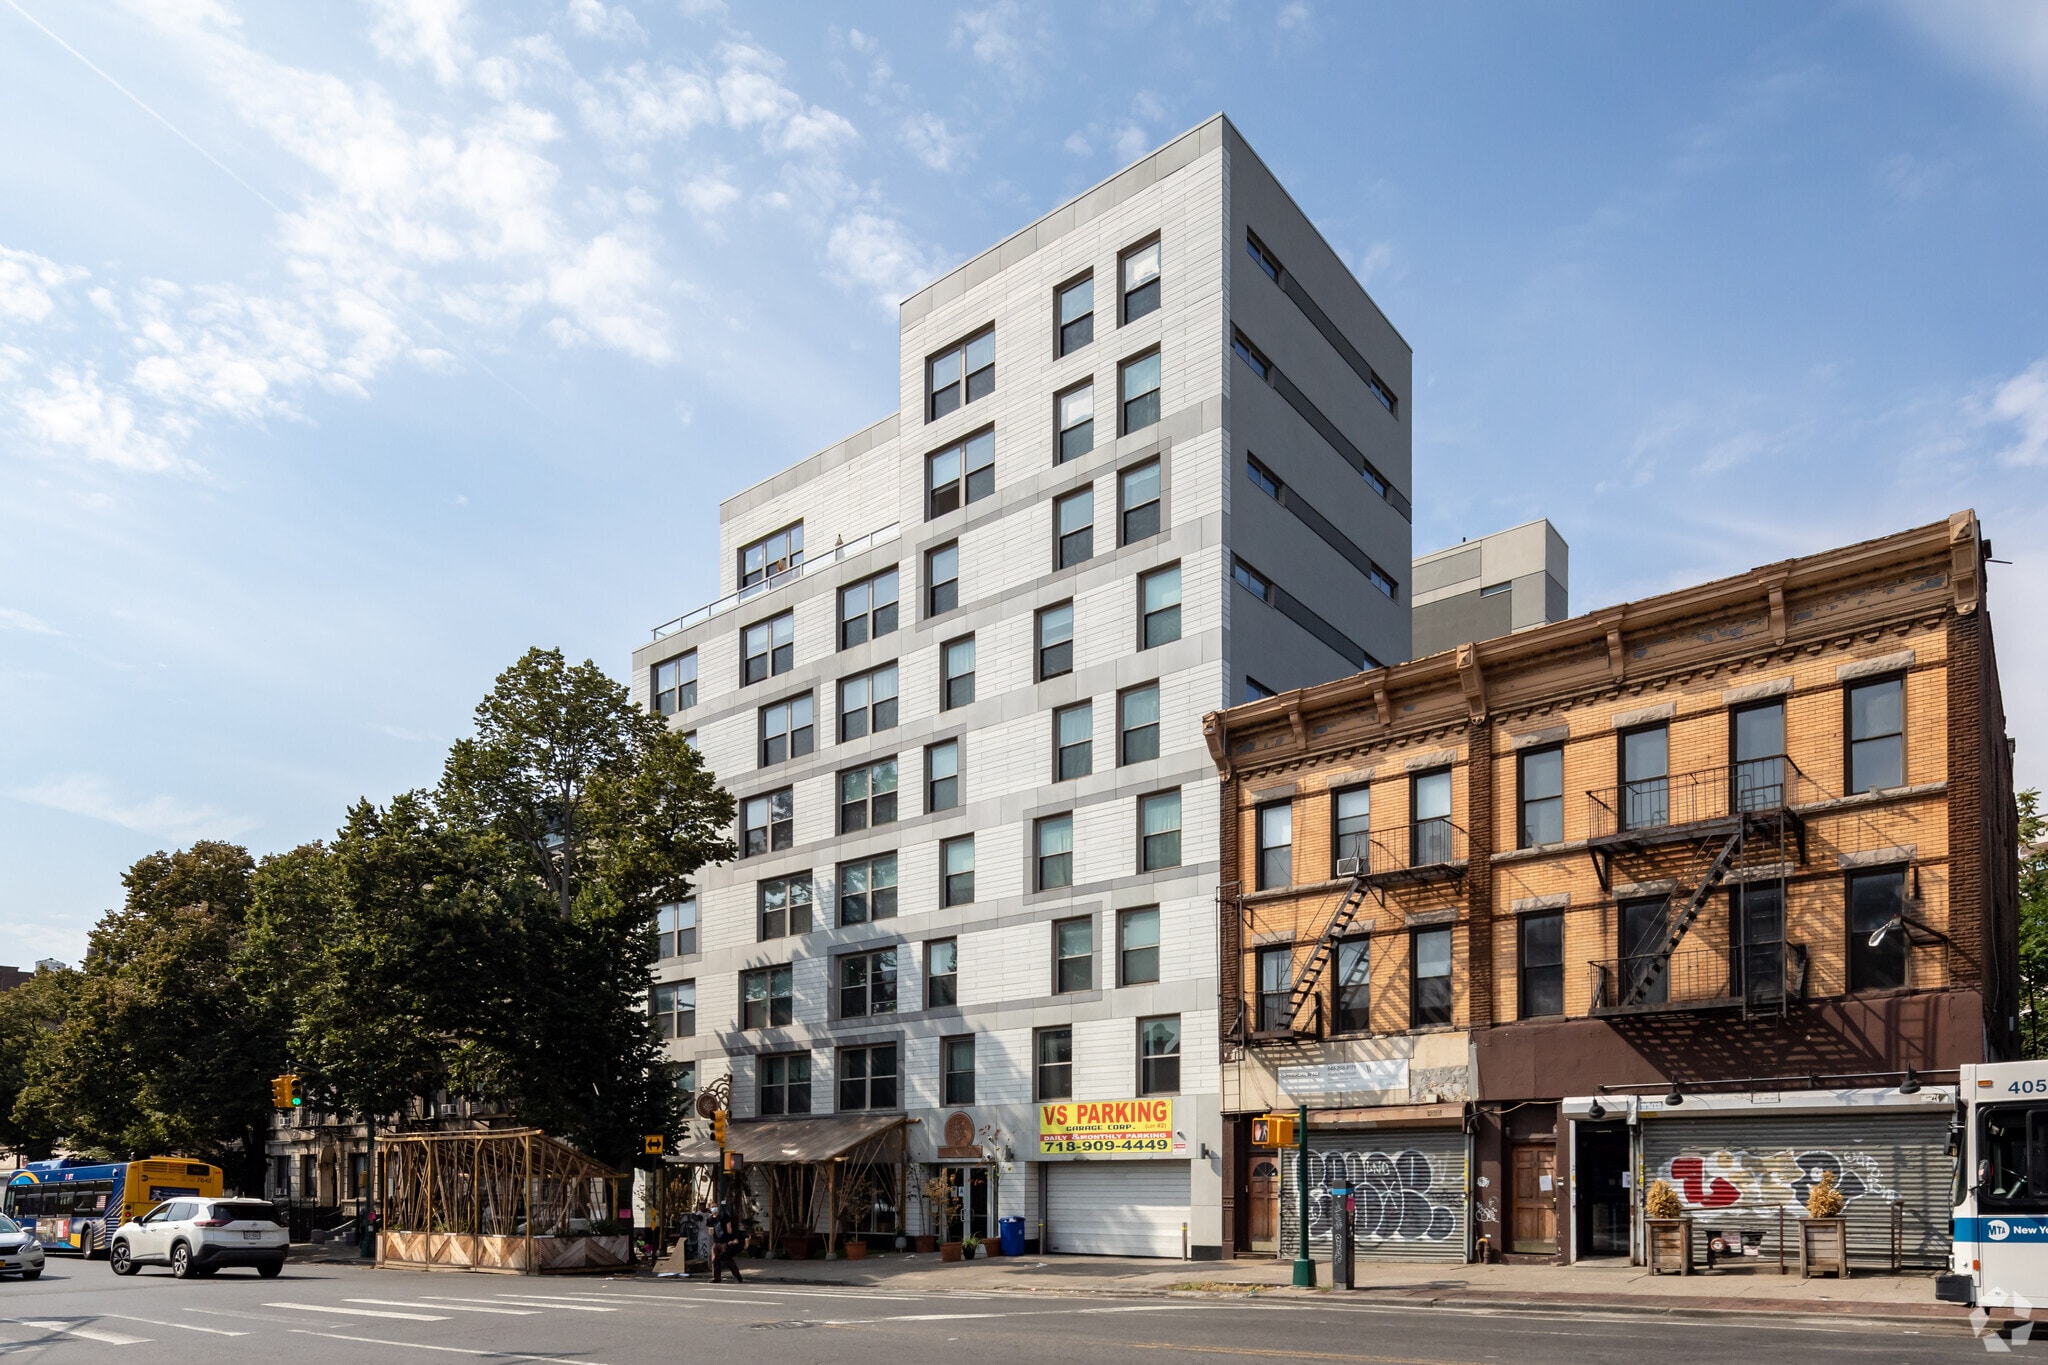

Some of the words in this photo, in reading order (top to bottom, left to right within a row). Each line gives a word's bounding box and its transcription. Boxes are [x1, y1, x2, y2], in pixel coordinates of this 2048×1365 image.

[2007, 1079, 2047, 1094] 405
[1043, 1105, 1068, 1126] VS
[1077, 1101, 1167, 1124] PARKING
[1044, 1139, 1168, 1152] 718-909-4449
[2013, 1225, 2038, 1234] New
